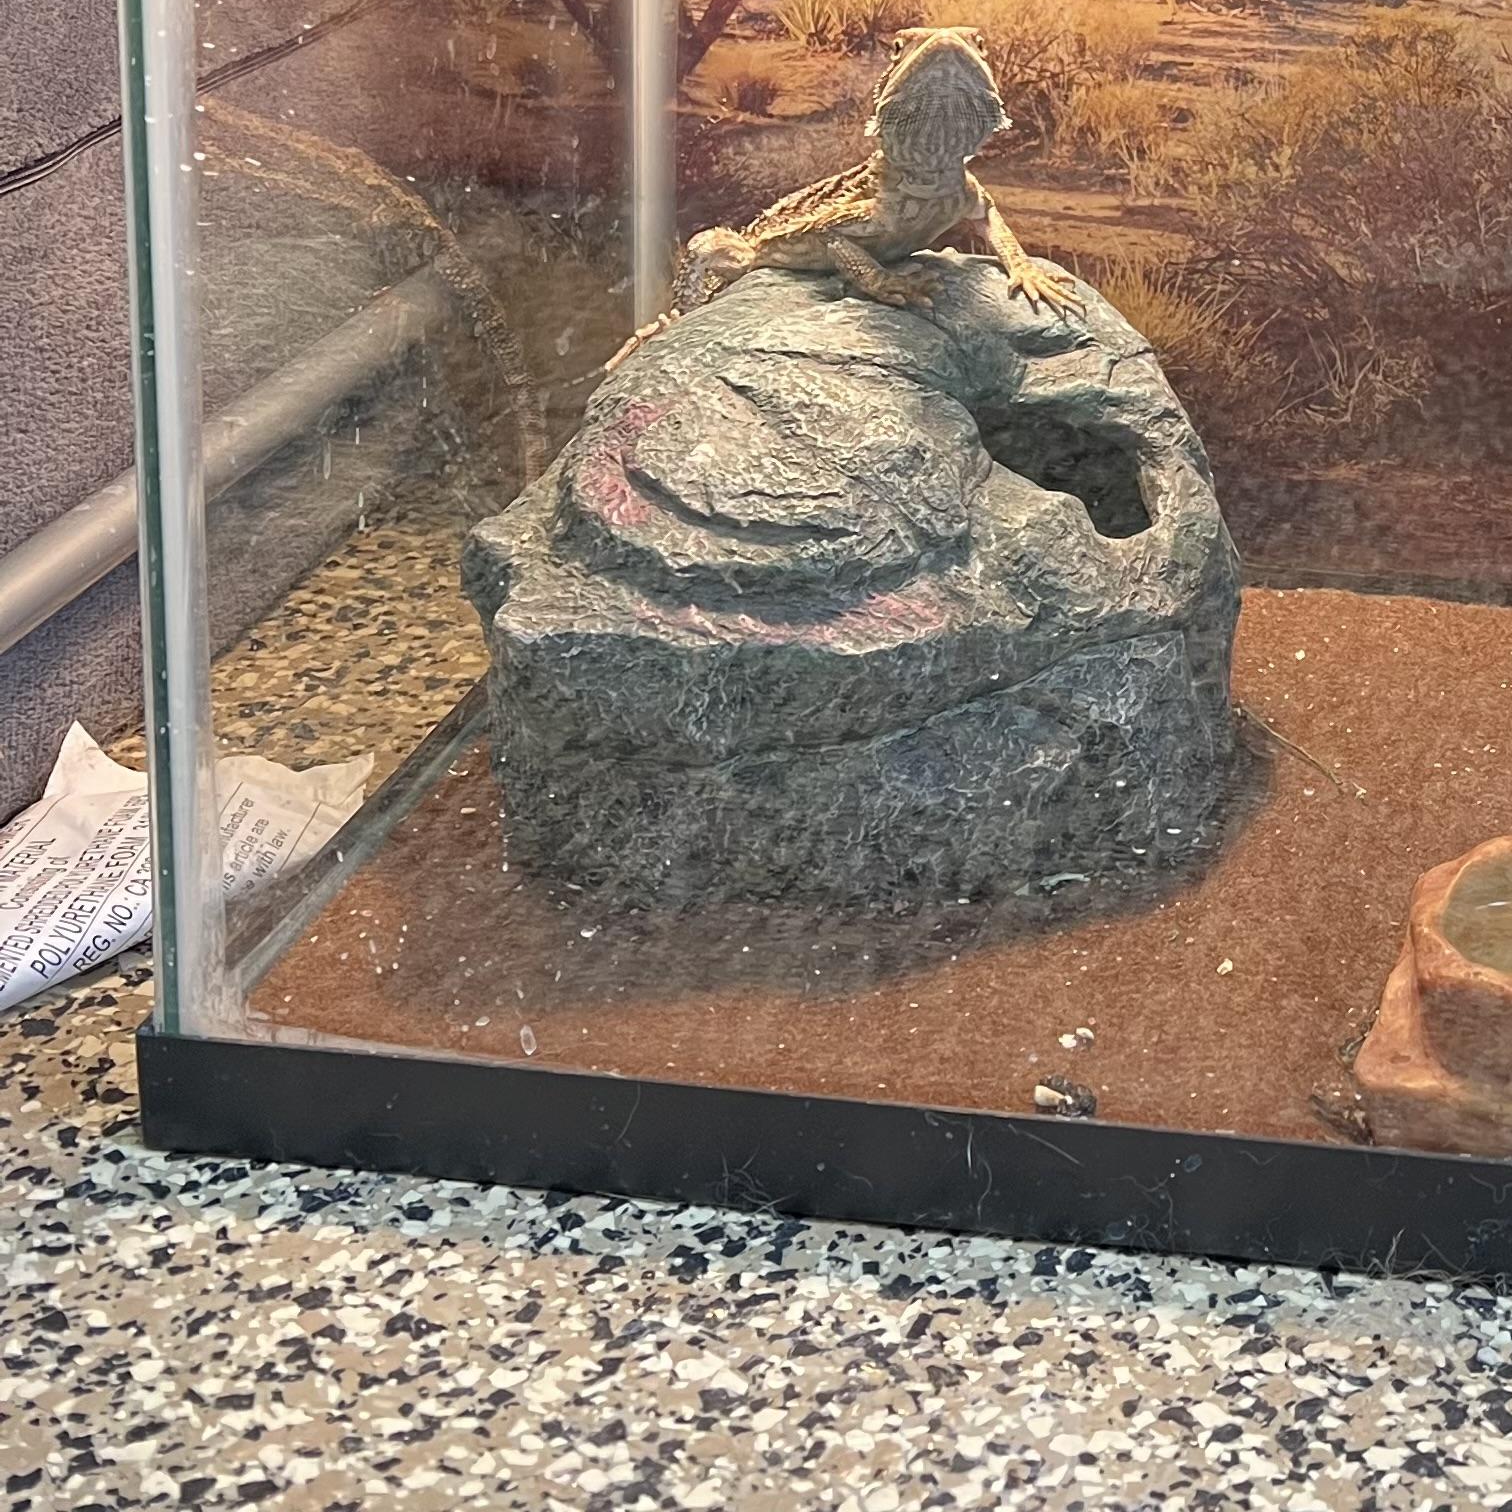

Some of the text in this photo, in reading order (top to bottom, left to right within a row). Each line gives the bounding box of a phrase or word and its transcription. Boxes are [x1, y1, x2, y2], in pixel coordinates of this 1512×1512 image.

[230, 836, 257, 871] article
[252, 819, 269, 835] are
[253, 850, 276, 877] with
[30, 837, 148, 979] POLYURETHANE FOAM
[73, 935, 116, 971] REG.
[125, 879, 152, 896] CA
